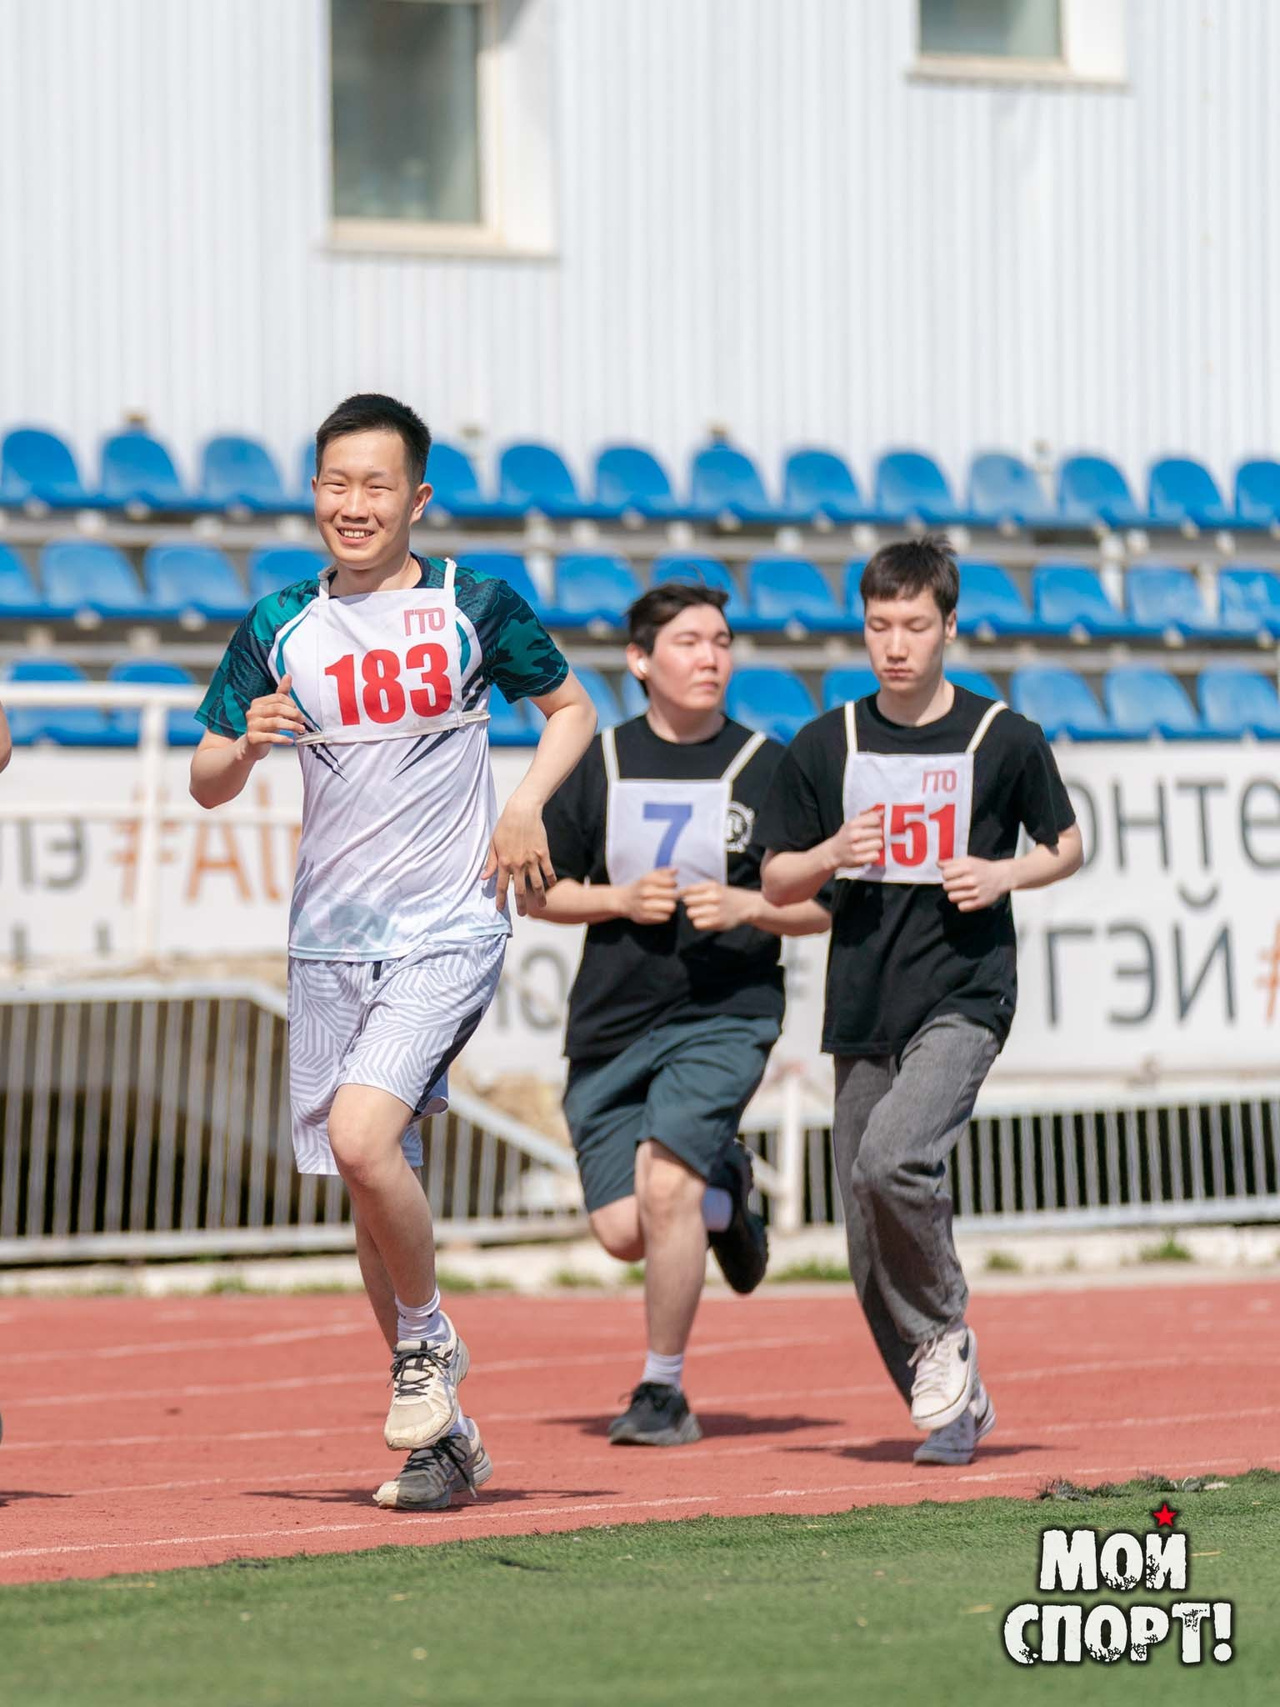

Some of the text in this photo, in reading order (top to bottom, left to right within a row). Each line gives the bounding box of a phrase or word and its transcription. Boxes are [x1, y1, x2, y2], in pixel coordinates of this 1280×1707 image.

[403, 607, 446, 636] ГТО
[324, 642, 453, 726] 183
[921, 768, 958, 795] ГТО
[642, 803, 692, 869] 7
[1018, 882, 1236, 1028] ГЭЙ
